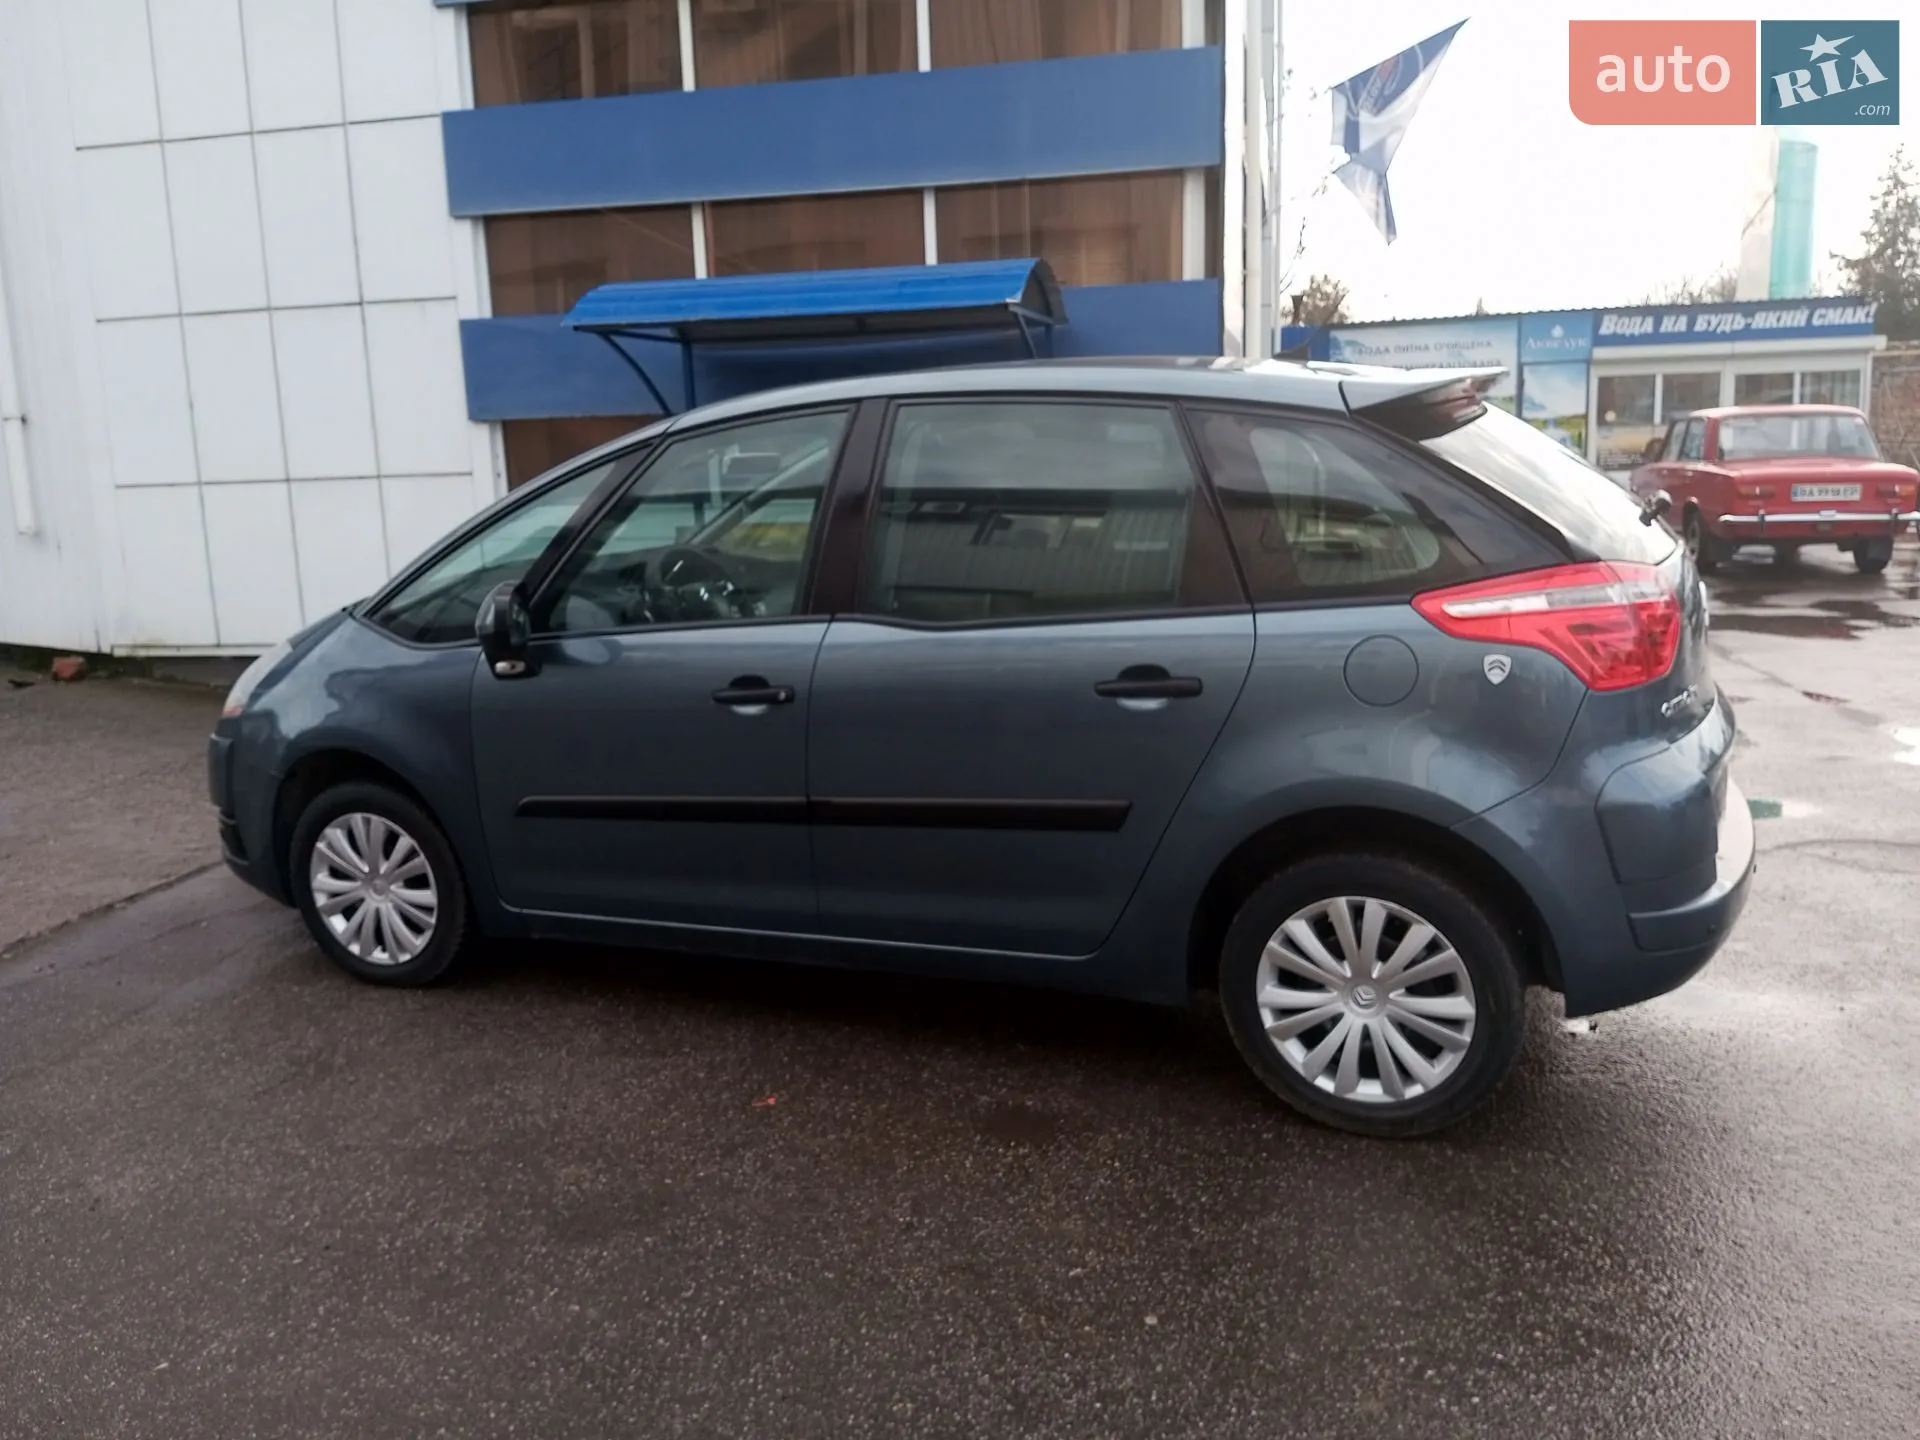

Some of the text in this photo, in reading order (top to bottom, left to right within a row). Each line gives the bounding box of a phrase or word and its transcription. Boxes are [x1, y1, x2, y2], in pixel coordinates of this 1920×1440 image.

[1598, 302, 1878, 337] ВОДА НА БУДЬ-ЯКИЙ СМАК!
